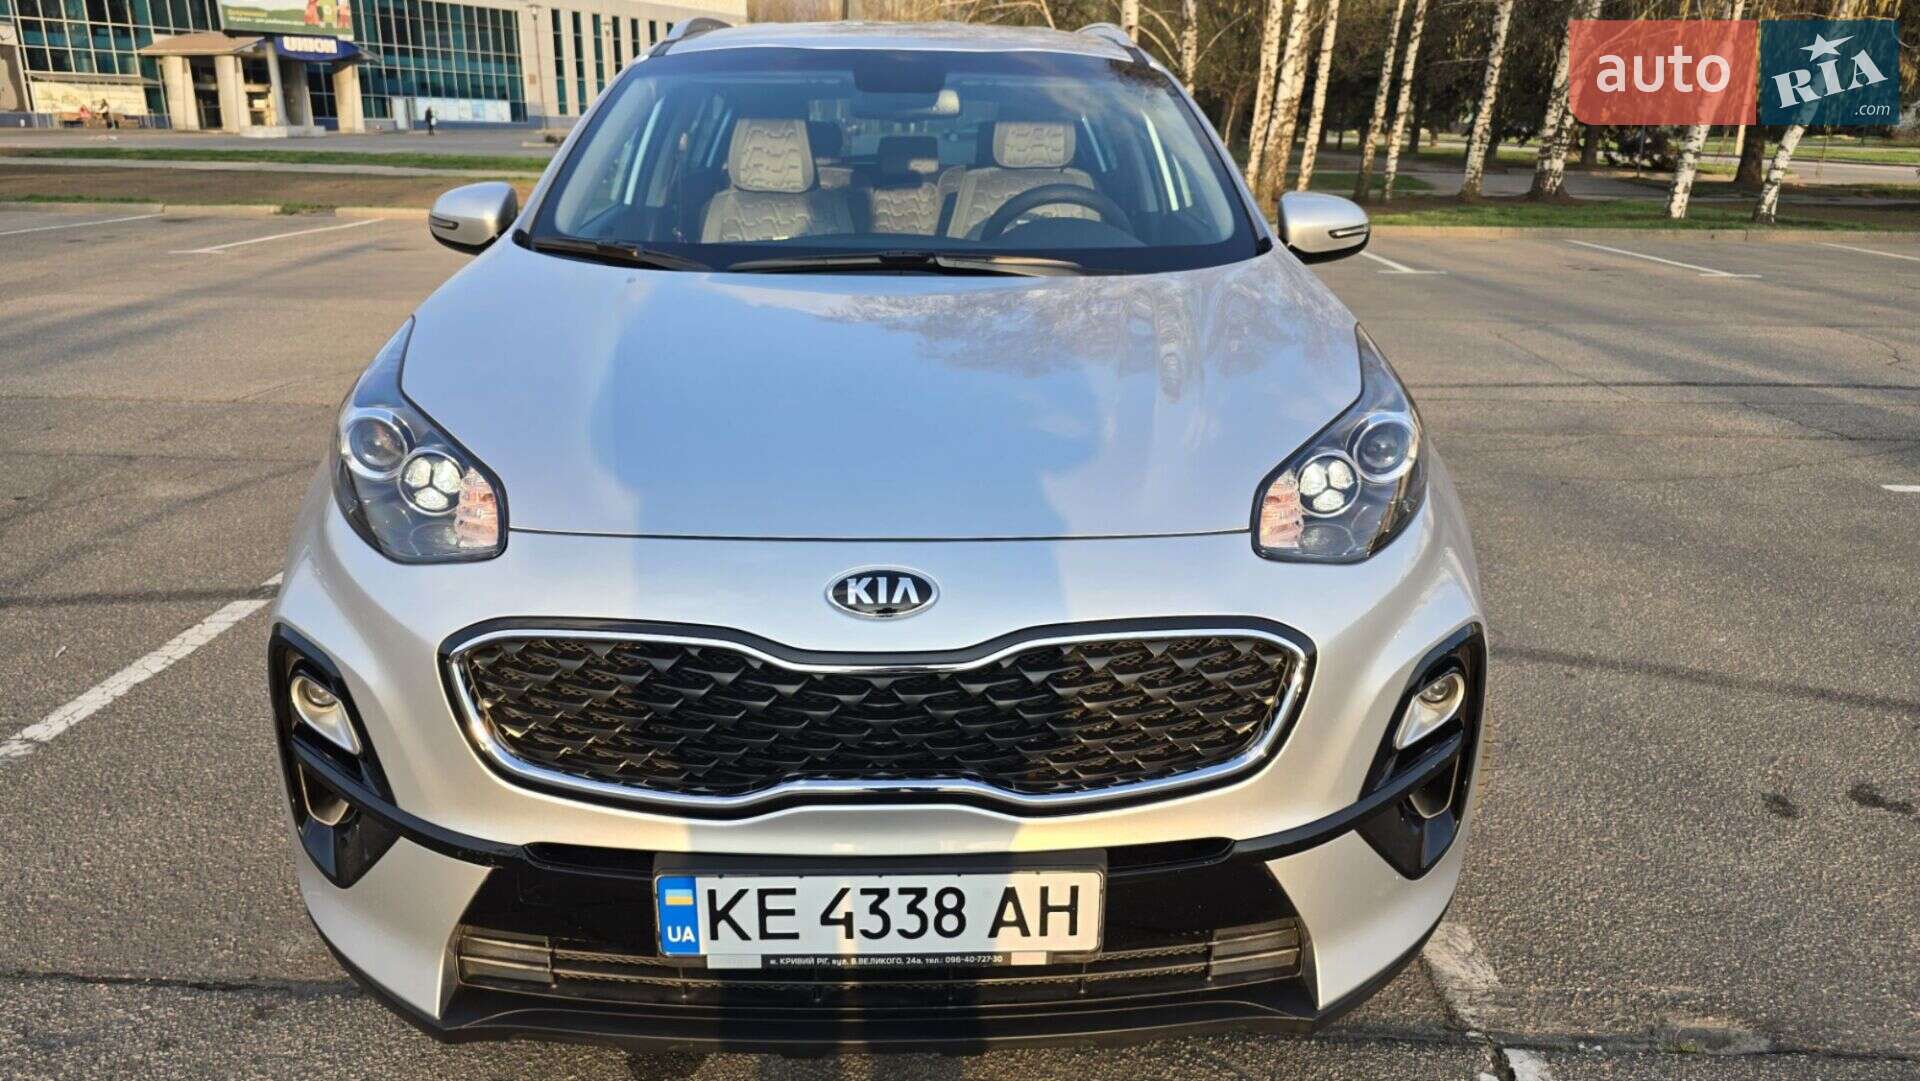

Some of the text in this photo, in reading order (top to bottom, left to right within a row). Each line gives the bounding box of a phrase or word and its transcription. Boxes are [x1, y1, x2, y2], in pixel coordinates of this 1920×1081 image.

[847, 577, 920, 605] KIA
[707, 885, 1079, 941] KE 4338 AH
[667, 926, 696, 943] UA
